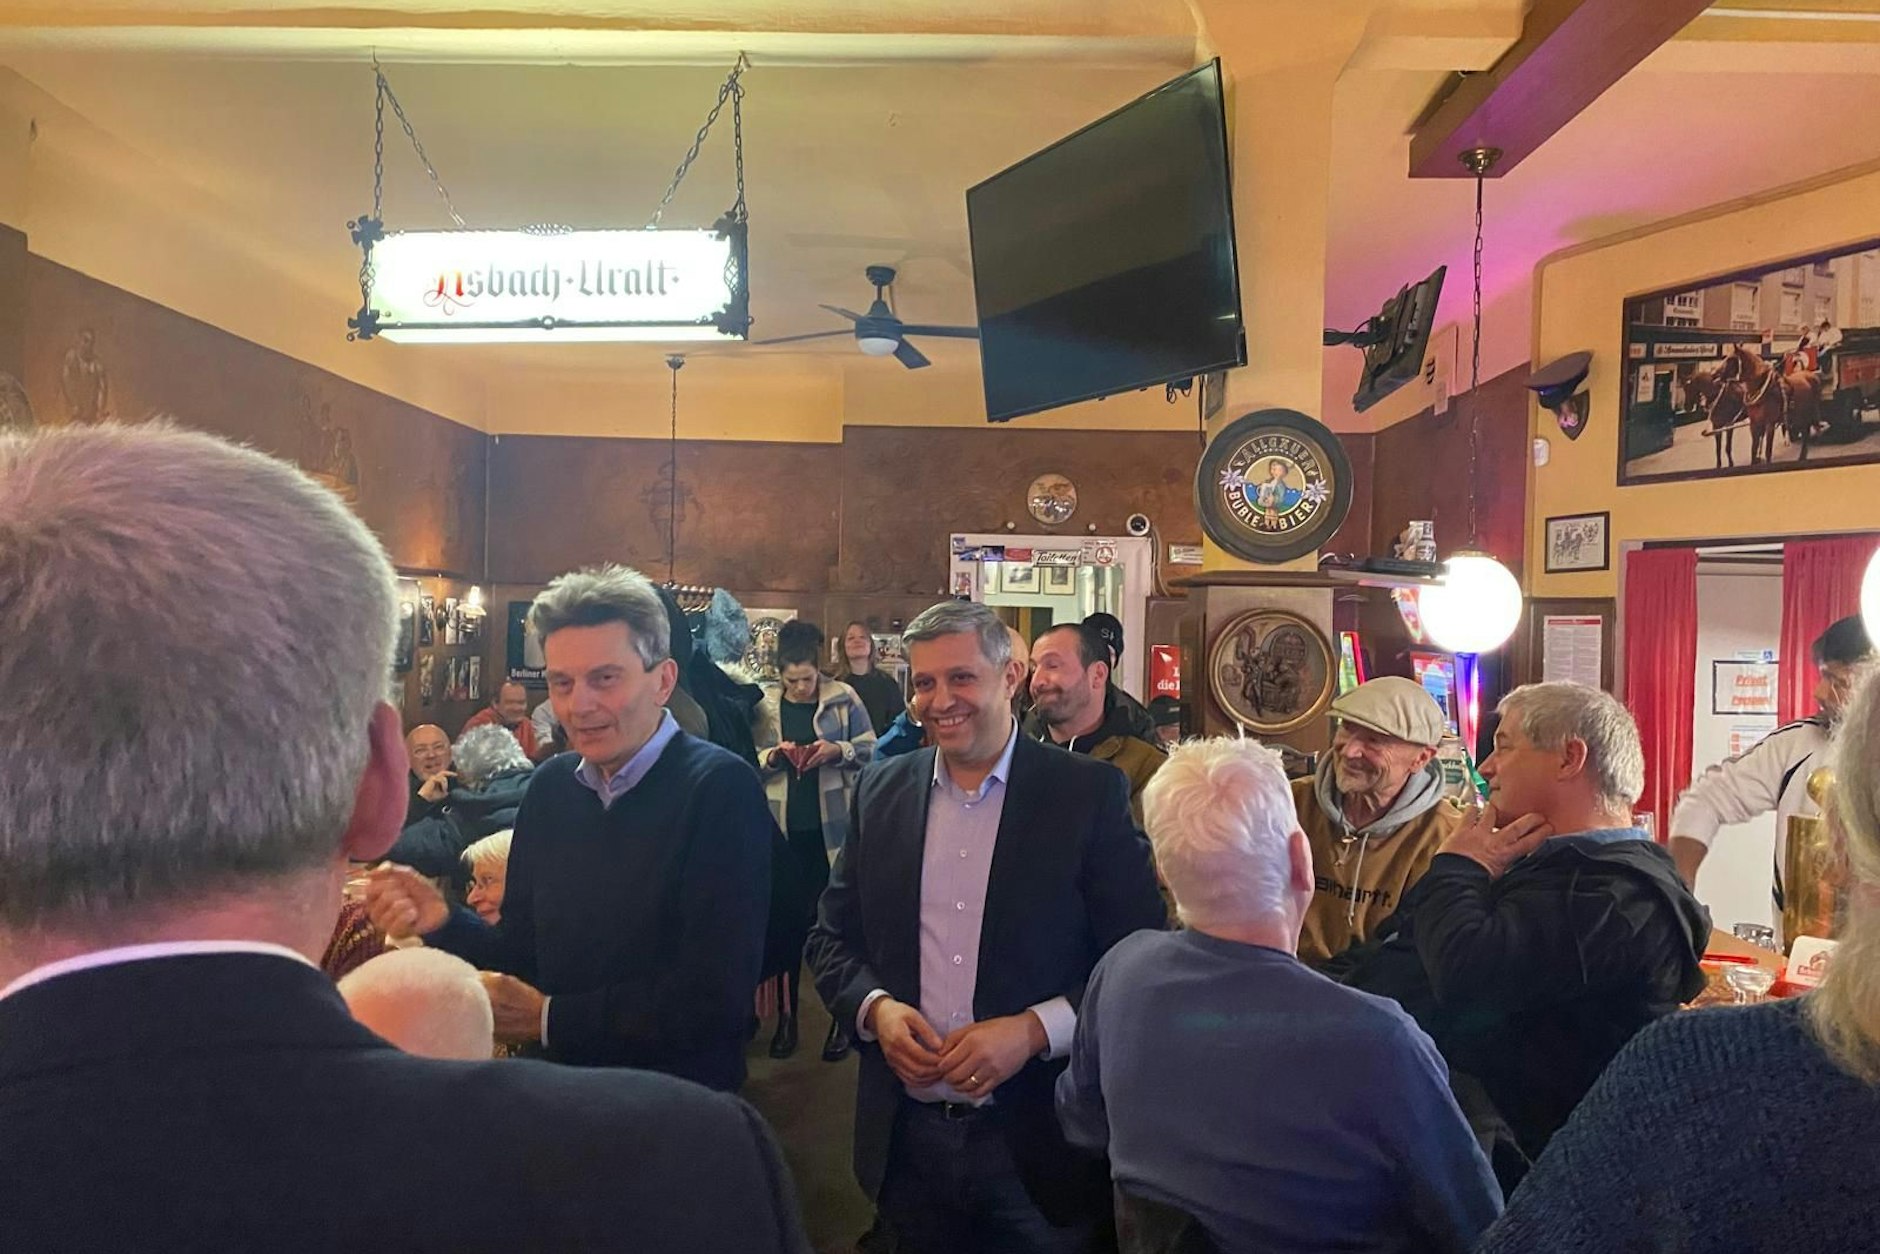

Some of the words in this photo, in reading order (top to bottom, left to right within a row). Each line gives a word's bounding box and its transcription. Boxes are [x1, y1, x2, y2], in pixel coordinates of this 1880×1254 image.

[1279, 501, 1314, 530] BIER
[1037, 551, 1077, 562] Toiletten
[511, 668, 540, 679] Berliner
